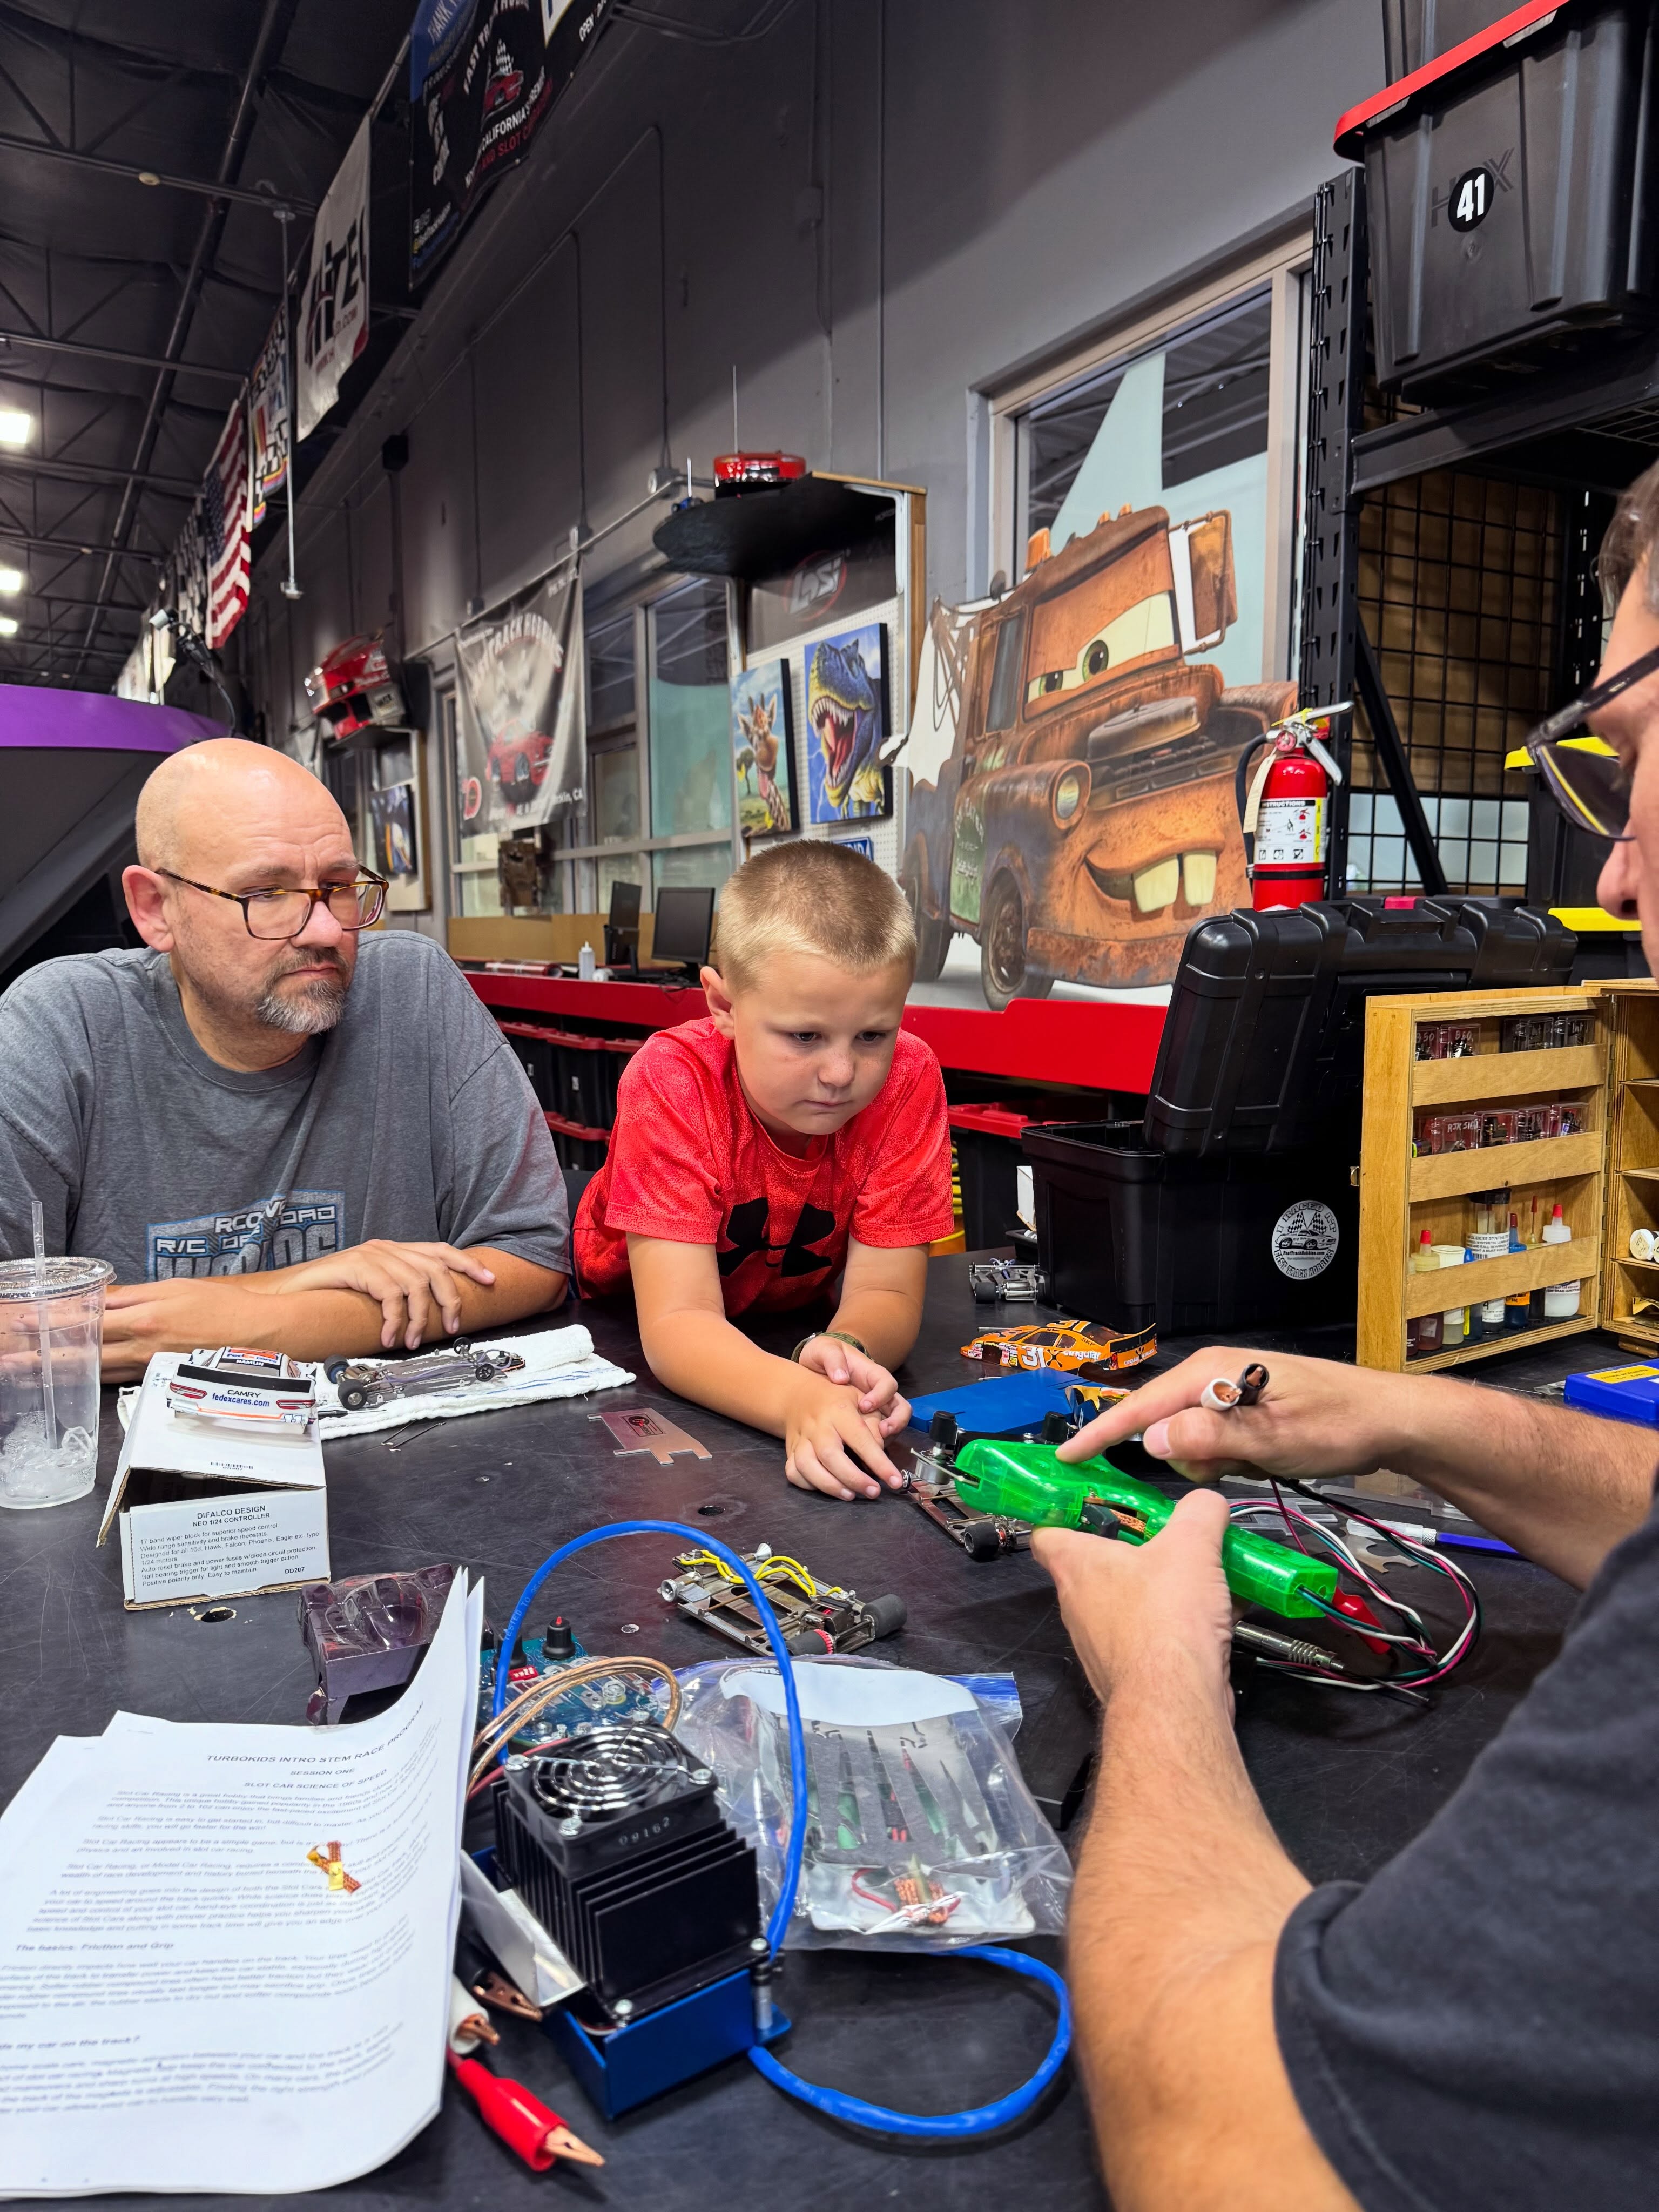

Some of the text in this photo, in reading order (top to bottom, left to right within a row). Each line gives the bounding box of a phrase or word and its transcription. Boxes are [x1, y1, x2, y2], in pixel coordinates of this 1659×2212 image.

[497, 133, 521, 157] SLOT
[1457, 174, 1486, 222] 41
[1282, 1202, 1324, 1222] RACED
[156, 1238, 206, 1254] R/C
[1274, 1249, 1334, 1278] FAST TRACK HOBBIES
[1021, 1345, 1047, 1368] 31
[1062, 1349, 1102, 1361] cingular
[212, 1393, 270, 1407] fedexcares.com
[227, 1390, 261, 1398] CAMRY
[197, 1505, 266, 1519] DIFALCO DESIGN
[224, 1513, 270, 1523] CONTROLLER
[177, 1539, 206, 1547] sensitivity
[140, 1550, 170, 1559] Designed
[179, 1568, 199, 1576] trigger
[260, 1557, 279, 1565] trigger
[168, 1576, 190, 1584] polarity
[504, 1609, 522, 1641] TESTED
[319, 1755, 352, 1763] STEM
[354, 1744, 385, 1759] RACE
[387, 1701, 423, 1746] PROGRAM
[357, 1769, 387, 1784] SPEED
[345, 1790, 371, 1800] friends
[80, 1943, 123, 1951] Friction
[150, 1941, 174, 1950] Grip
